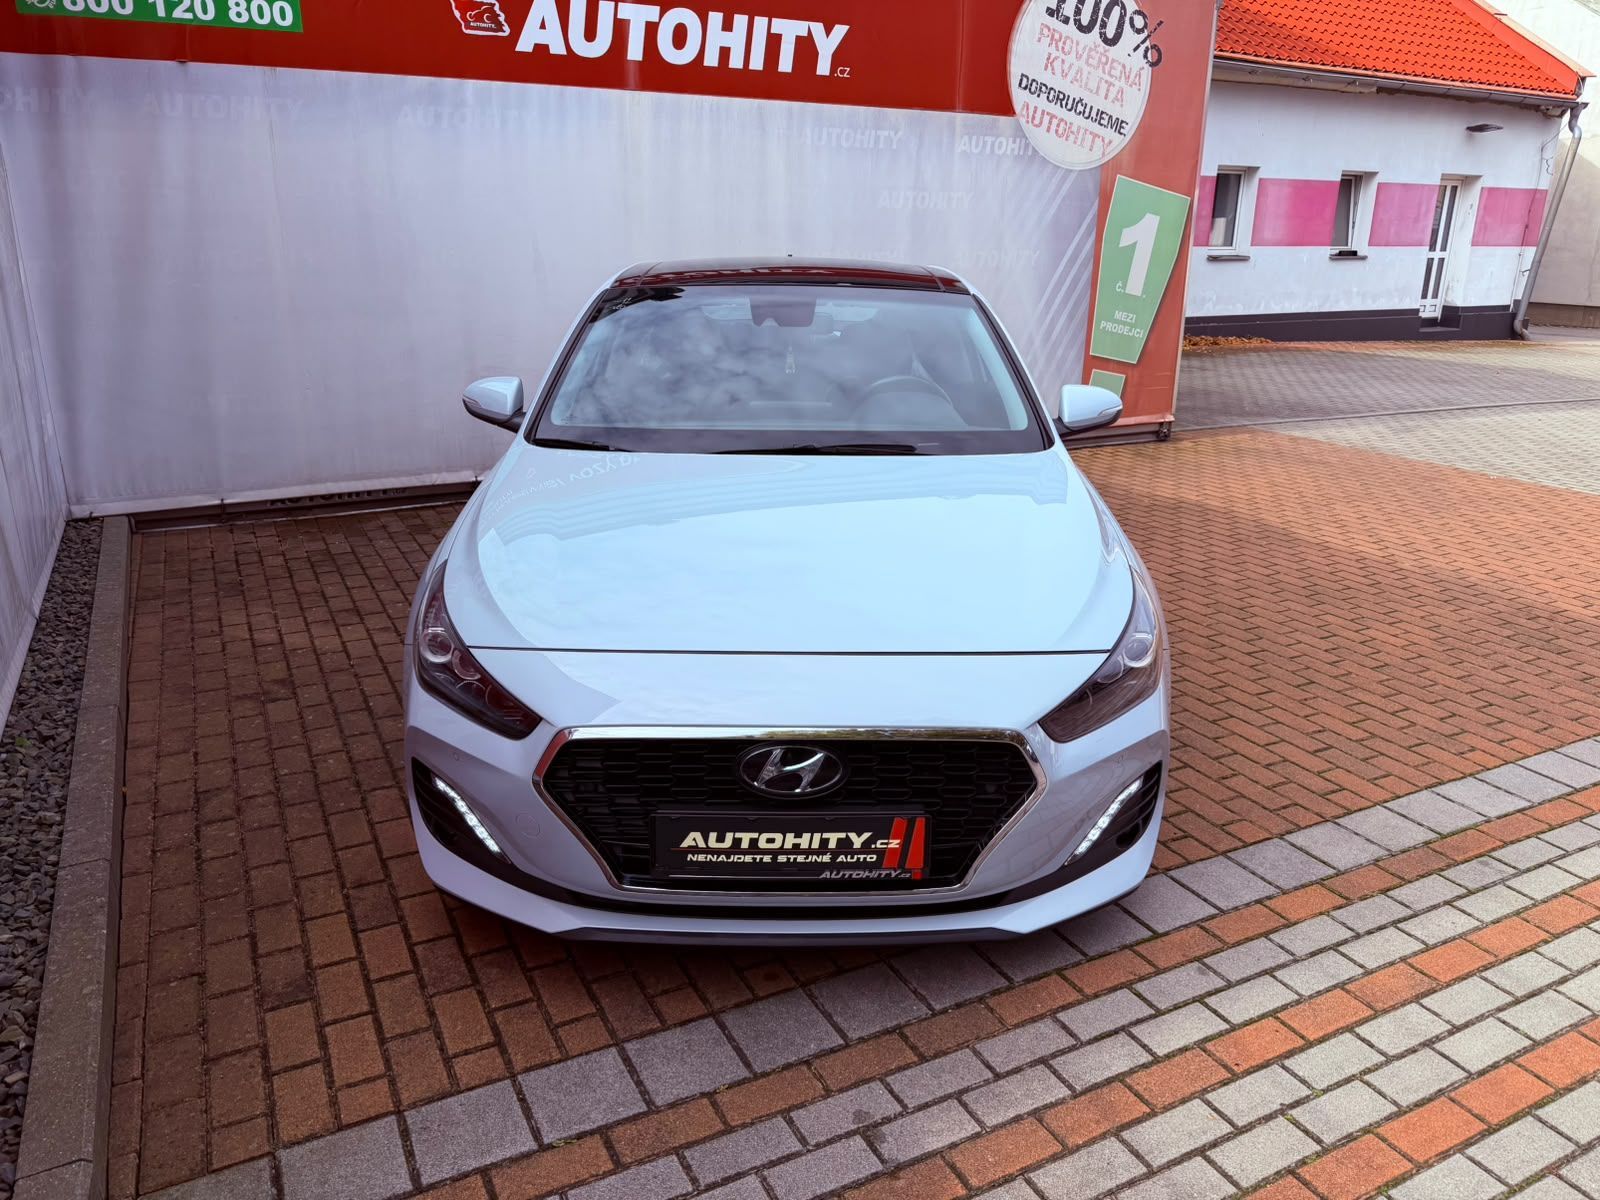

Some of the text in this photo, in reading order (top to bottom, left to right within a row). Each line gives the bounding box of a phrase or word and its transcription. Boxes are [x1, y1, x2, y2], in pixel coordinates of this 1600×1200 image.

[147, 0, 216, 21] 120
[227, 0, 294, 27] 800
[1037, 22, 1145, 92] PROVĚŘENÁ
[1044, 52, 1125, 109] KVALITA
[1018, 73, 1129, 138] DOPORUČUJEME
[802, 127, 903, 150] AUTOHITY
[1019, 101, 1114, 159] AUTOHITY
[1100, 320, 1144, 338] PRODEJCI
[1114, 310, 1137, 323] MEZI
[687, 853, 877, 862] NENAJDETE STEJNÉ AUTO
